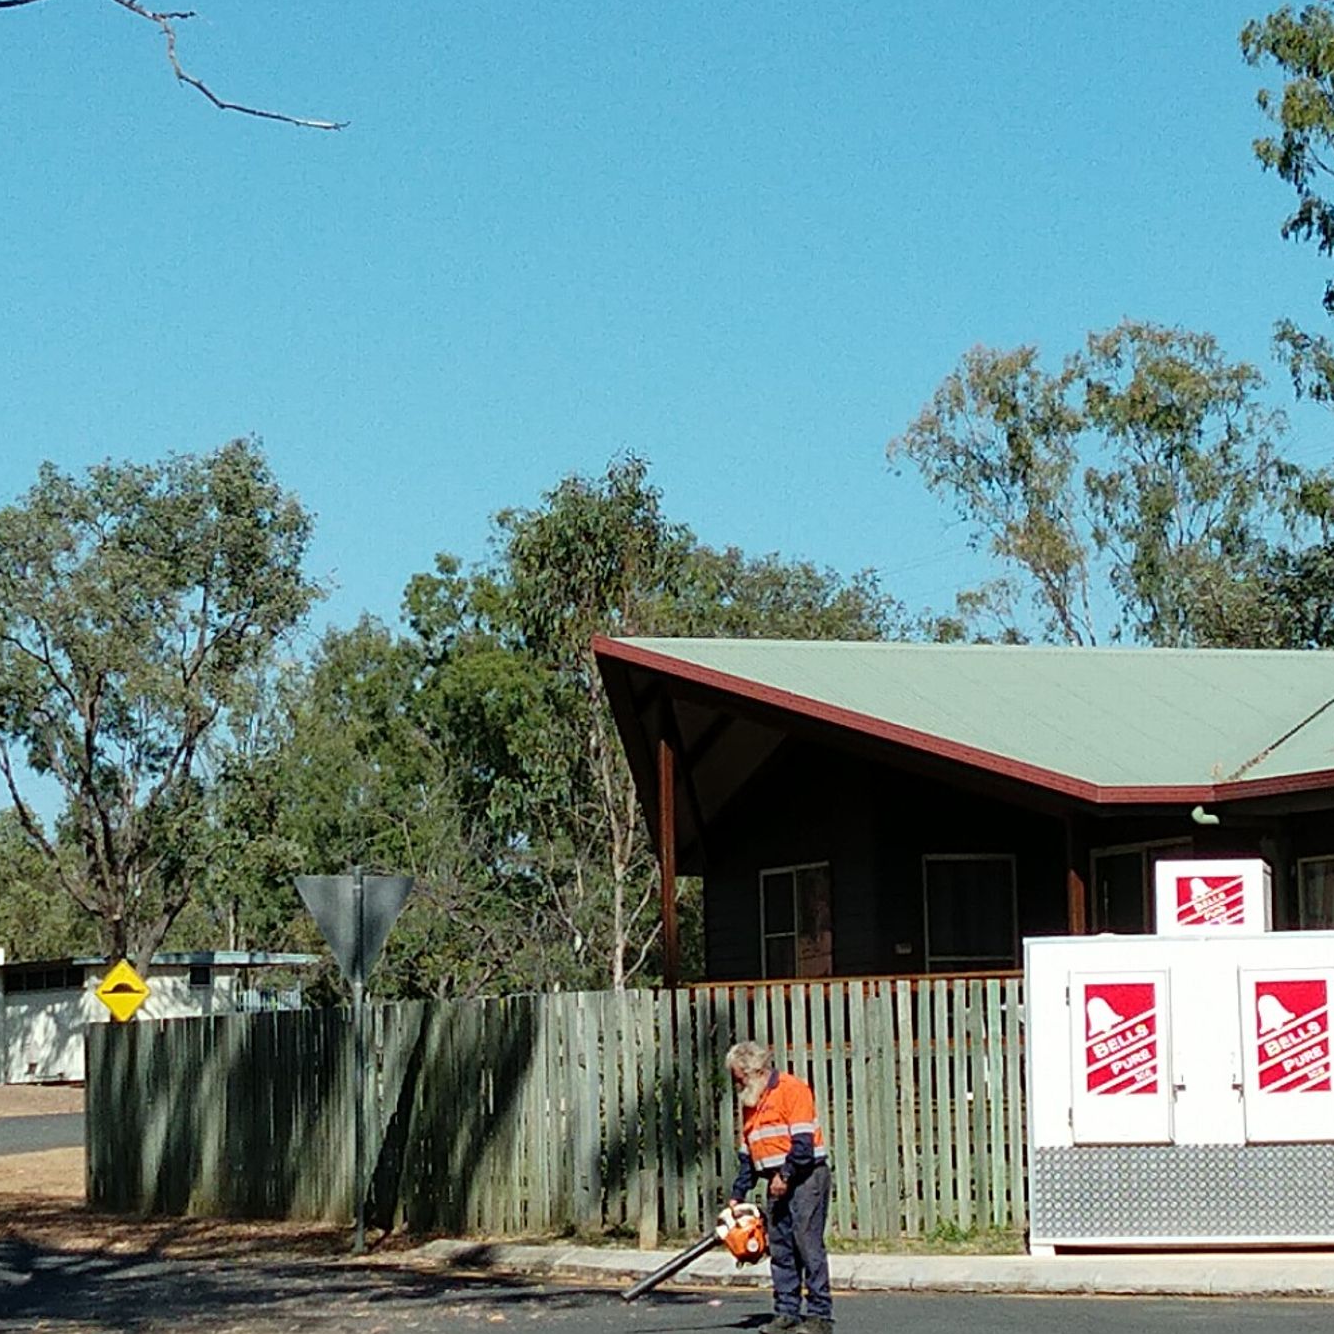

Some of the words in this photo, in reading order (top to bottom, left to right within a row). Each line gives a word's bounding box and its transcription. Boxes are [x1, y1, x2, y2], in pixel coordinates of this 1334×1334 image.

[1092, 1023, 1150, 1059] BELLS
[1263, 1021, 1322, 1057] BELLS
[1110, 1048, 1153, 1076] PURE
[1281, 1045, 1324, 1073] PURE
